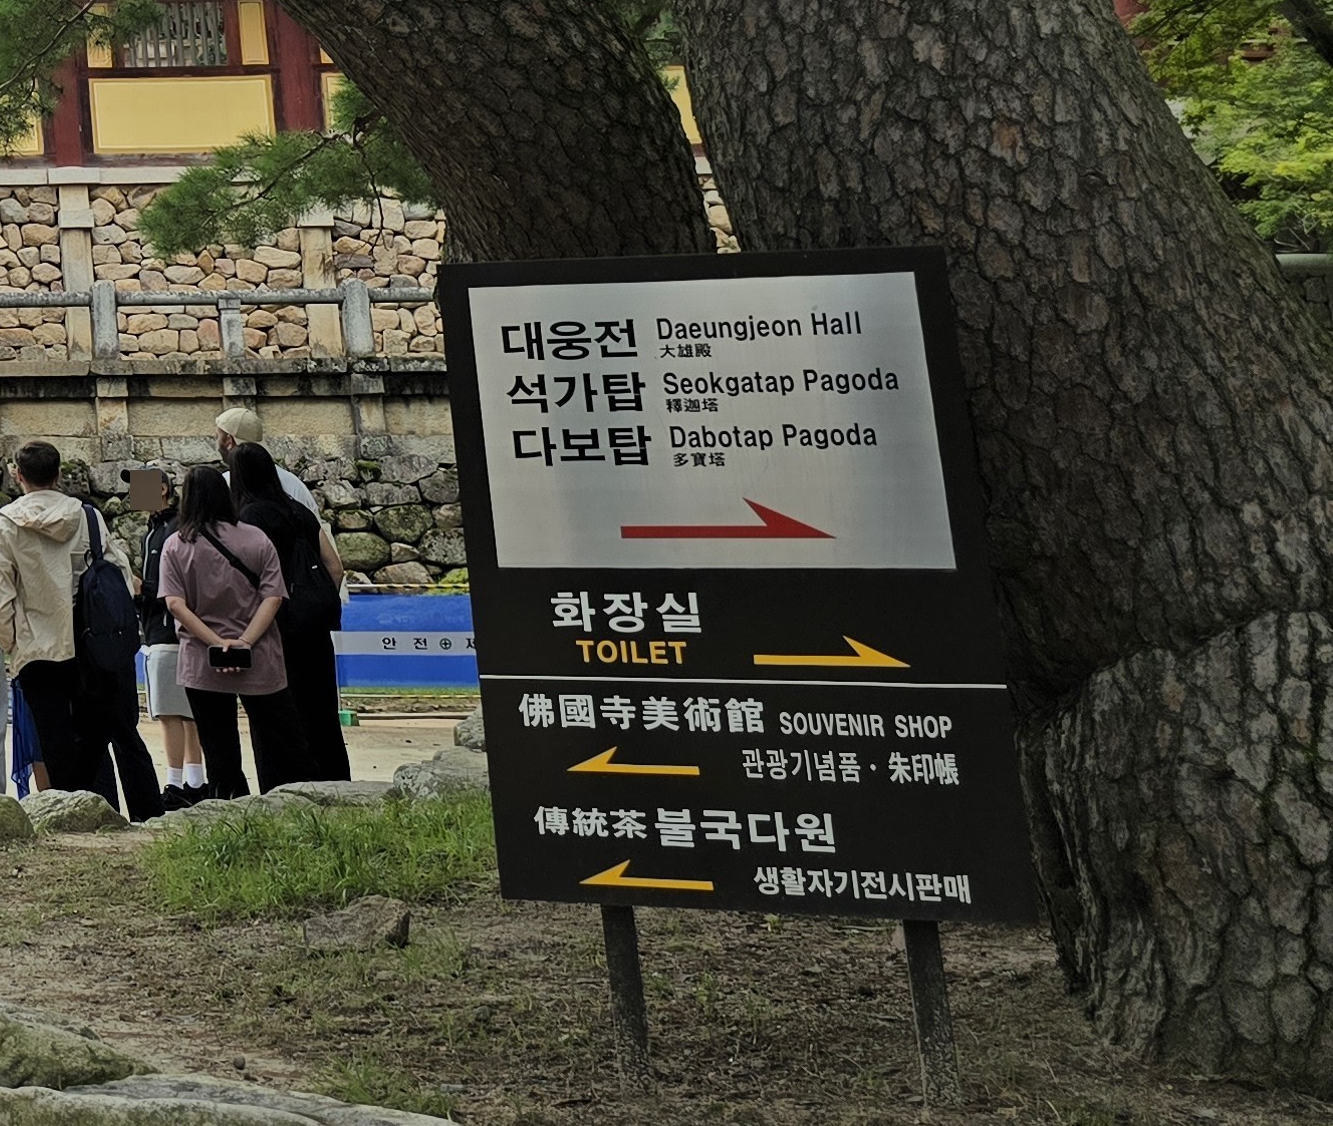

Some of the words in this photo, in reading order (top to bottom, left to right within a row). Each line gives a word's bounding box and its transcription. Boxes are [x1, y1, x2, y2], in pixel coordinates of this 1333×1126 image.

[501, 319, 638, 360] 대웅전
[656, 315, 801, 341] Daeungjeon
[811, 311, 861, 335] Hall
[660, 343, 712, 358] 大雄殿
[507, 372, 646, 413] 석가탑
[663, 372, 794, 396] Seokgatap
[803, 367, 899, 394] Pagoda
[513, 426, 651, 466] 다보탑
[670, 426, 773, 450] Dabotap
[782, 423, 877, 449] Pagoda
[551, 592, 701, 633] 화장실
[576, 640, 686, 664] TOILET
[519, 694, 764, 733] 佛國寺美術館
[780, 712, 884, 737] SOUVENIR
[895, 715, 952, 738] SHOP
[742, 749, 861, 783] 관광기념품
[888, 752, 959, 785] 朱印帳
[534, 806, 647, 838] 傳統茶
[655, 808, 835, 853] 불국다원
[754, 867, 971, 904] 생활자기전시판매
